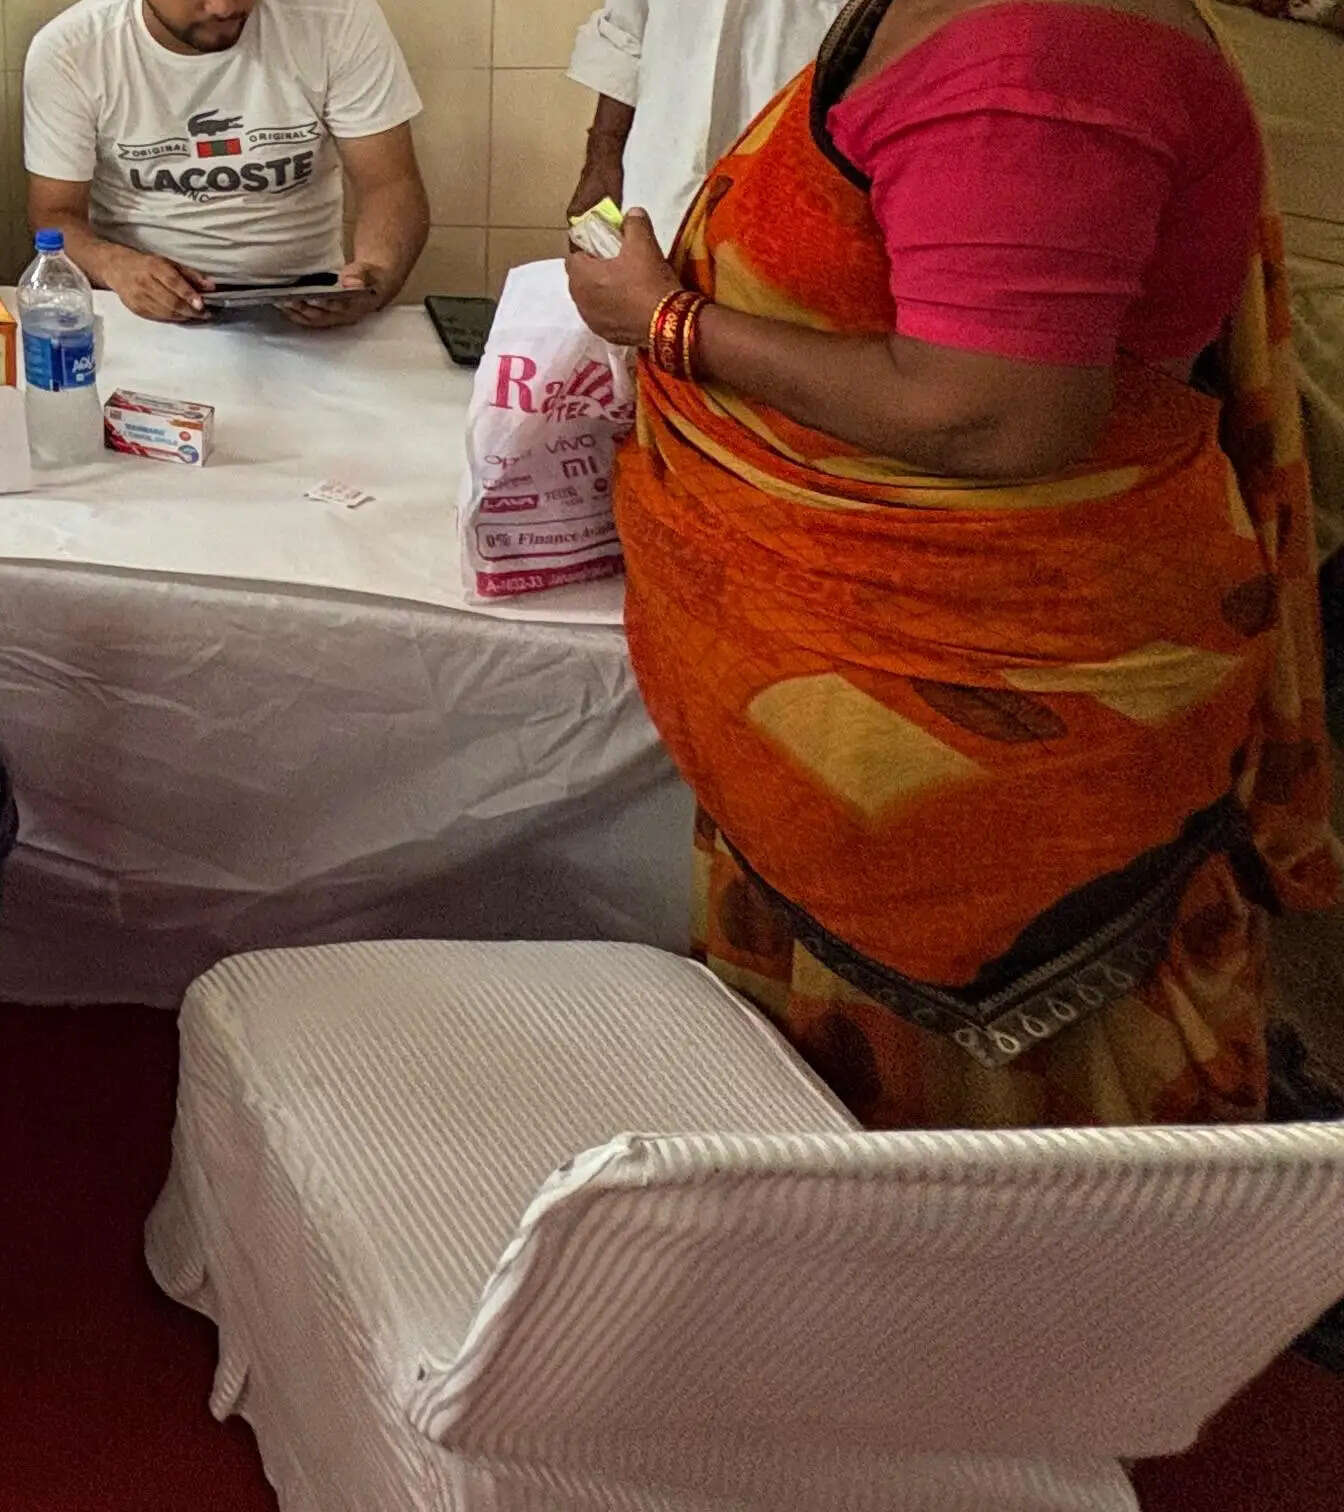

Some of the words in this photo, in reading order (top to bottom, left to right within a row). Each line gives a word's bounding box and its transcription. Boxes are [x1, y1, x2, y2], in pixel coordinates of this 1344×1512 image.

[132, 144, 187, 157] ORIGINAL
[249, 130, 307, 142] ORIGINAL
[130, 151, 313, 192] LACOSTE
[519, 530, 576, 544] Finance
